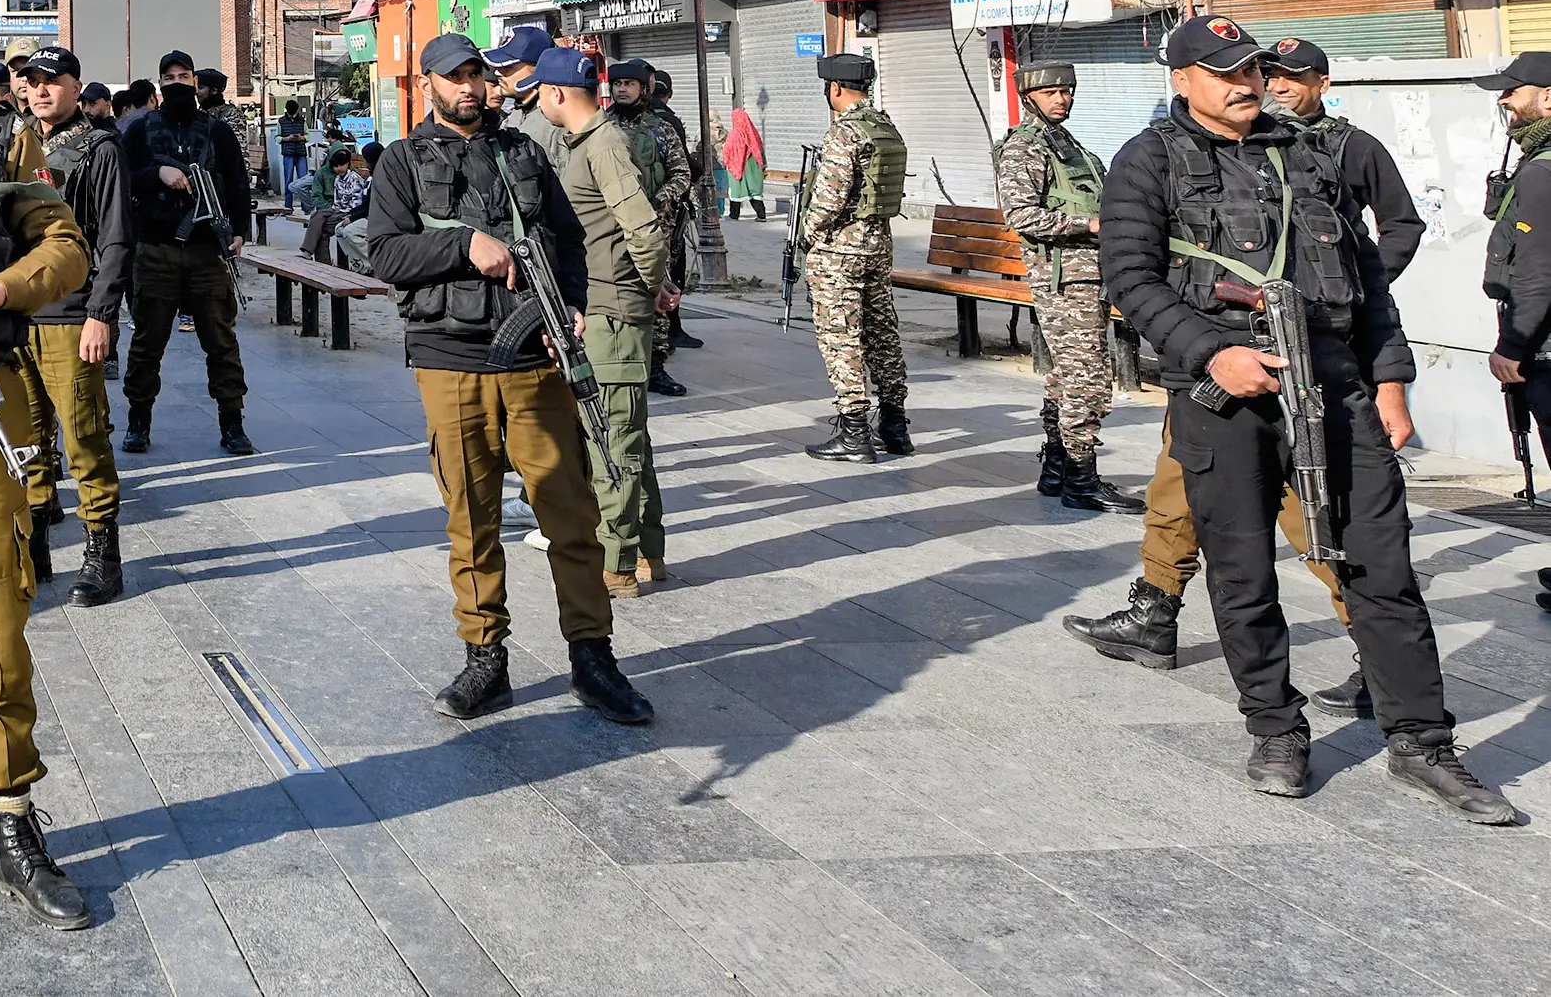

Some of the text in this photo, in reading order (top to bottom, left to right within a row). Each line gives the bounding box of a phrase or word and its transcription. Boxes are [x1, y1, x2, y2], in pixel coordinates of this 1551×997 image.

[29, 17, 48, 26] BIN
[616, 13, 652, 28] RESTAURANT
[660, 9, 678, 22] CAFE
